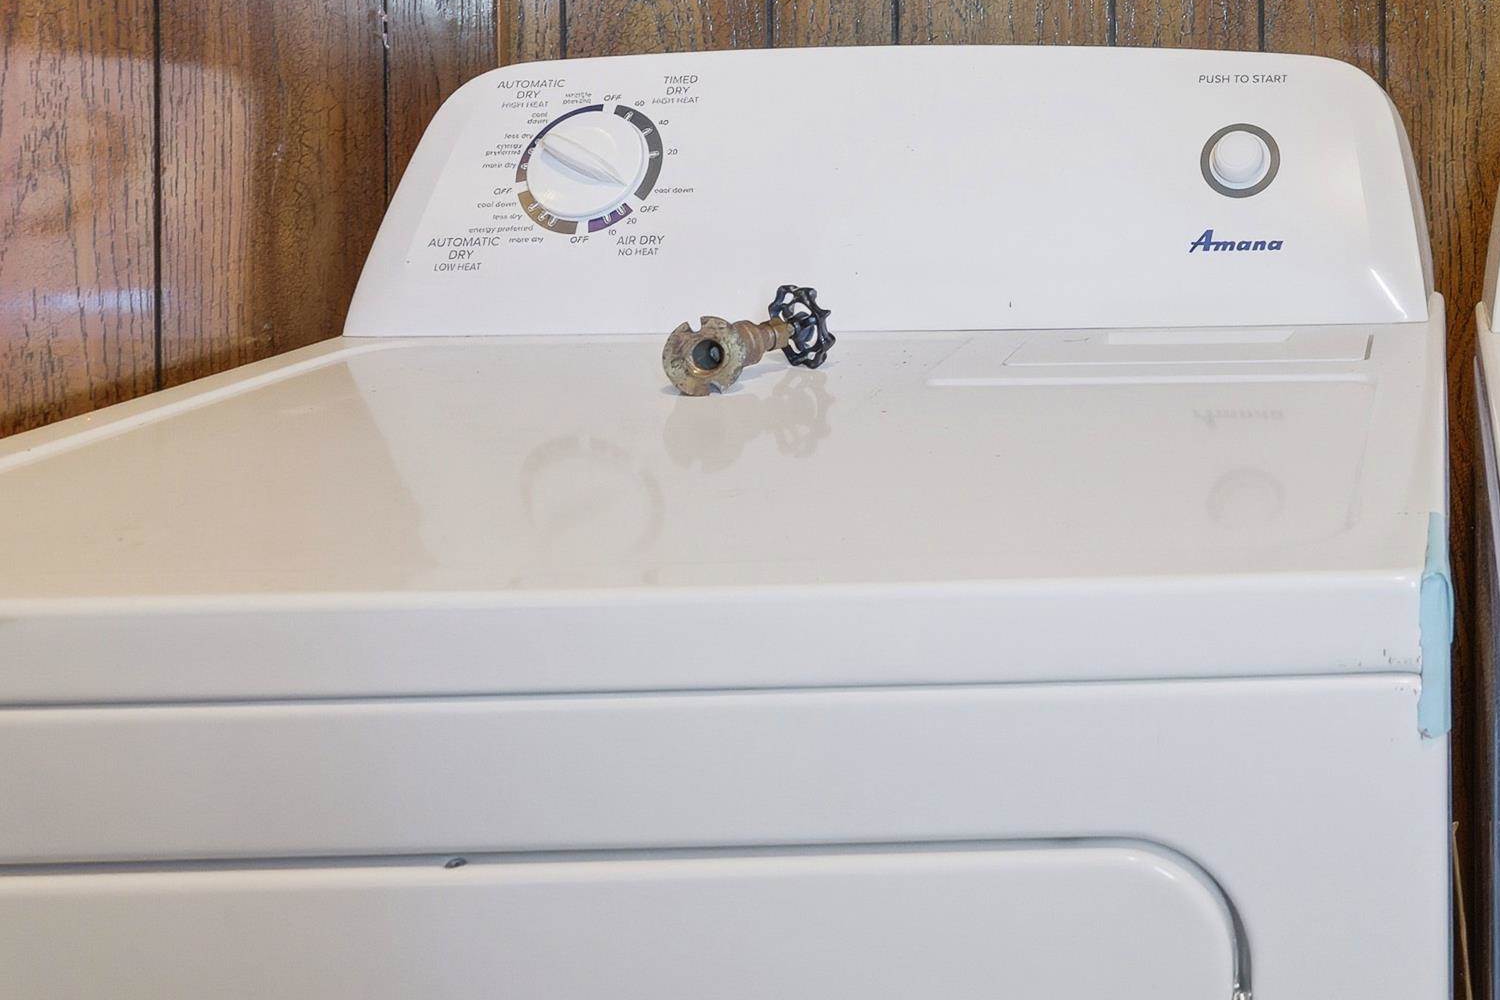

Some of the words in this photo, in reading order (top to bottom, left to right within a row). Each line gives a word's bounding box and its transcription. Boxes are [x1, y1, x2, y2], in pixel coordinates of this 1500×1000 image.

[663, 74, 699, 85] TIMED
[1198, 74, 1230, 84] PUSH
[1233, 74, 1249, 84] TO
[1252, 74, 1288, 84] START
[497, 79, 566, 89] AUTOMATIC
[516, 90, 541, 99] DRY
[666, 86, 691, 95] DRY
[603, 94, 622, 102] OFF
[677, 96, 700, 104] HEAT
[526, 100, 549, 108] HEAT
[667, 148, 678, 156] 20
[493, 187, 513, 196] OFF
[640, 205, 659, 213] OFF
[509, 213, 523, 221] dry
[428, 236, 501, 248] AUTOMATIC
[530, 236, 544, 244] dry
[569, 236, 589, 244] OFF
[616, 236, 636, 246] AIR
[639, 235, 665, 245] DRY
[1189, 229, 1283, 253] Amana
[448, 249, 474, 260] DRY
[617, 248, 633, 256] NO
[635, 247, 659, 256] HEAT
[433, 263, 456, 272] LOW
[457, 262, 482, 271] HEAT
